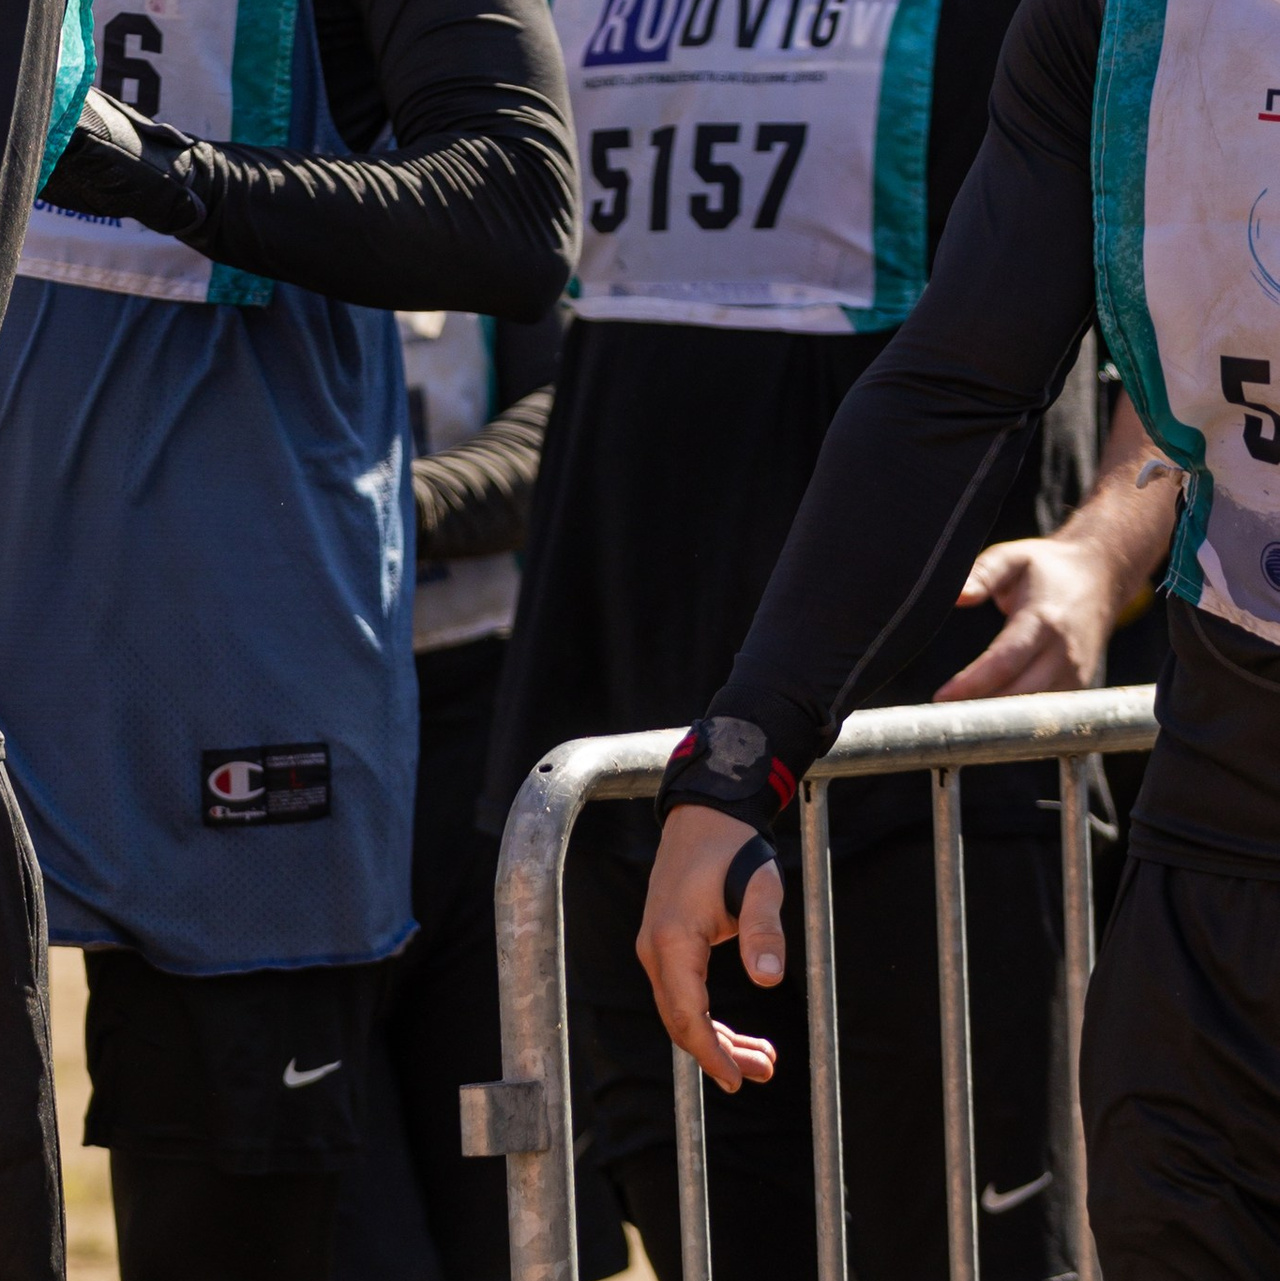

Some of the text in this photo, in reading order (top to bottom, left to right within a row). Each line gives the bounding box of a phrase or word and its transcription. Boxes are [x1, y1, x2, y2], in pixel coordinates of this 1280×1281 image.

[101, 11, 163, 120] 6
[589, 123, 808, 234] 5157
[1220, 354, 1280, 466] 5
